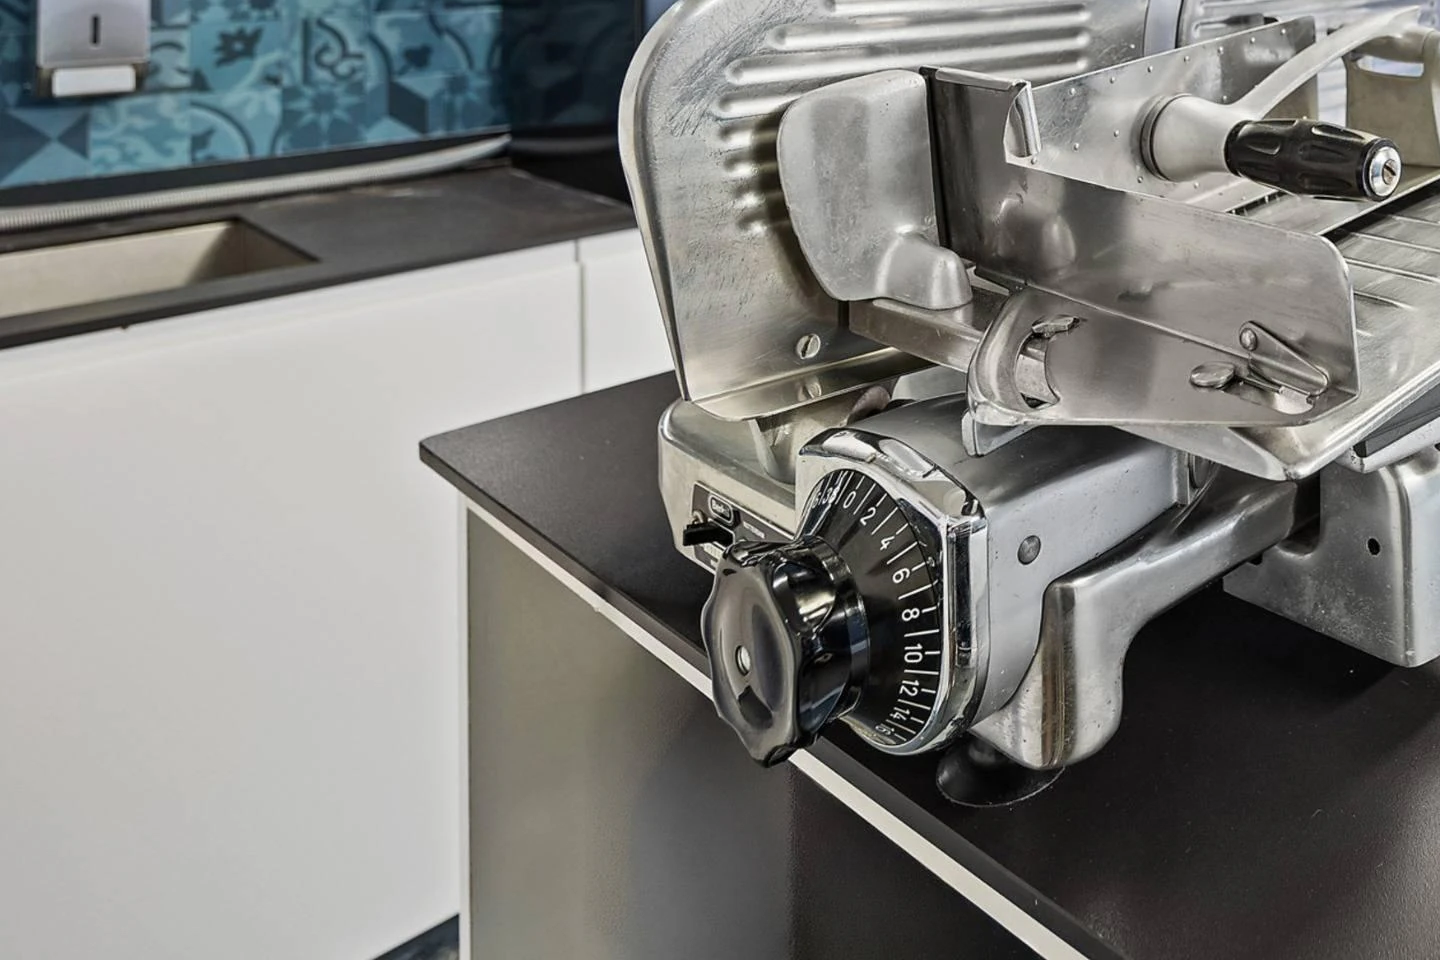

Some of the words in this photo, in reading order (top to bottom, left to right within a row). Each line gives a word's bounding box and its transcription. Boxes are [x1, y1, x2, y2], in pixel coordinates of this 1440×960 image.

[842, 491, 857, 509] 0
[860, 507, 876, 526] 2
[879, 535, 895, 551] 4
[892, 568, 910, 584] 6
[901, 607, 920, 622] 8
[904, 643, 923, 663] 10
[899, 679, 920, 697] 12
[889, 706, 911, 721] 14
